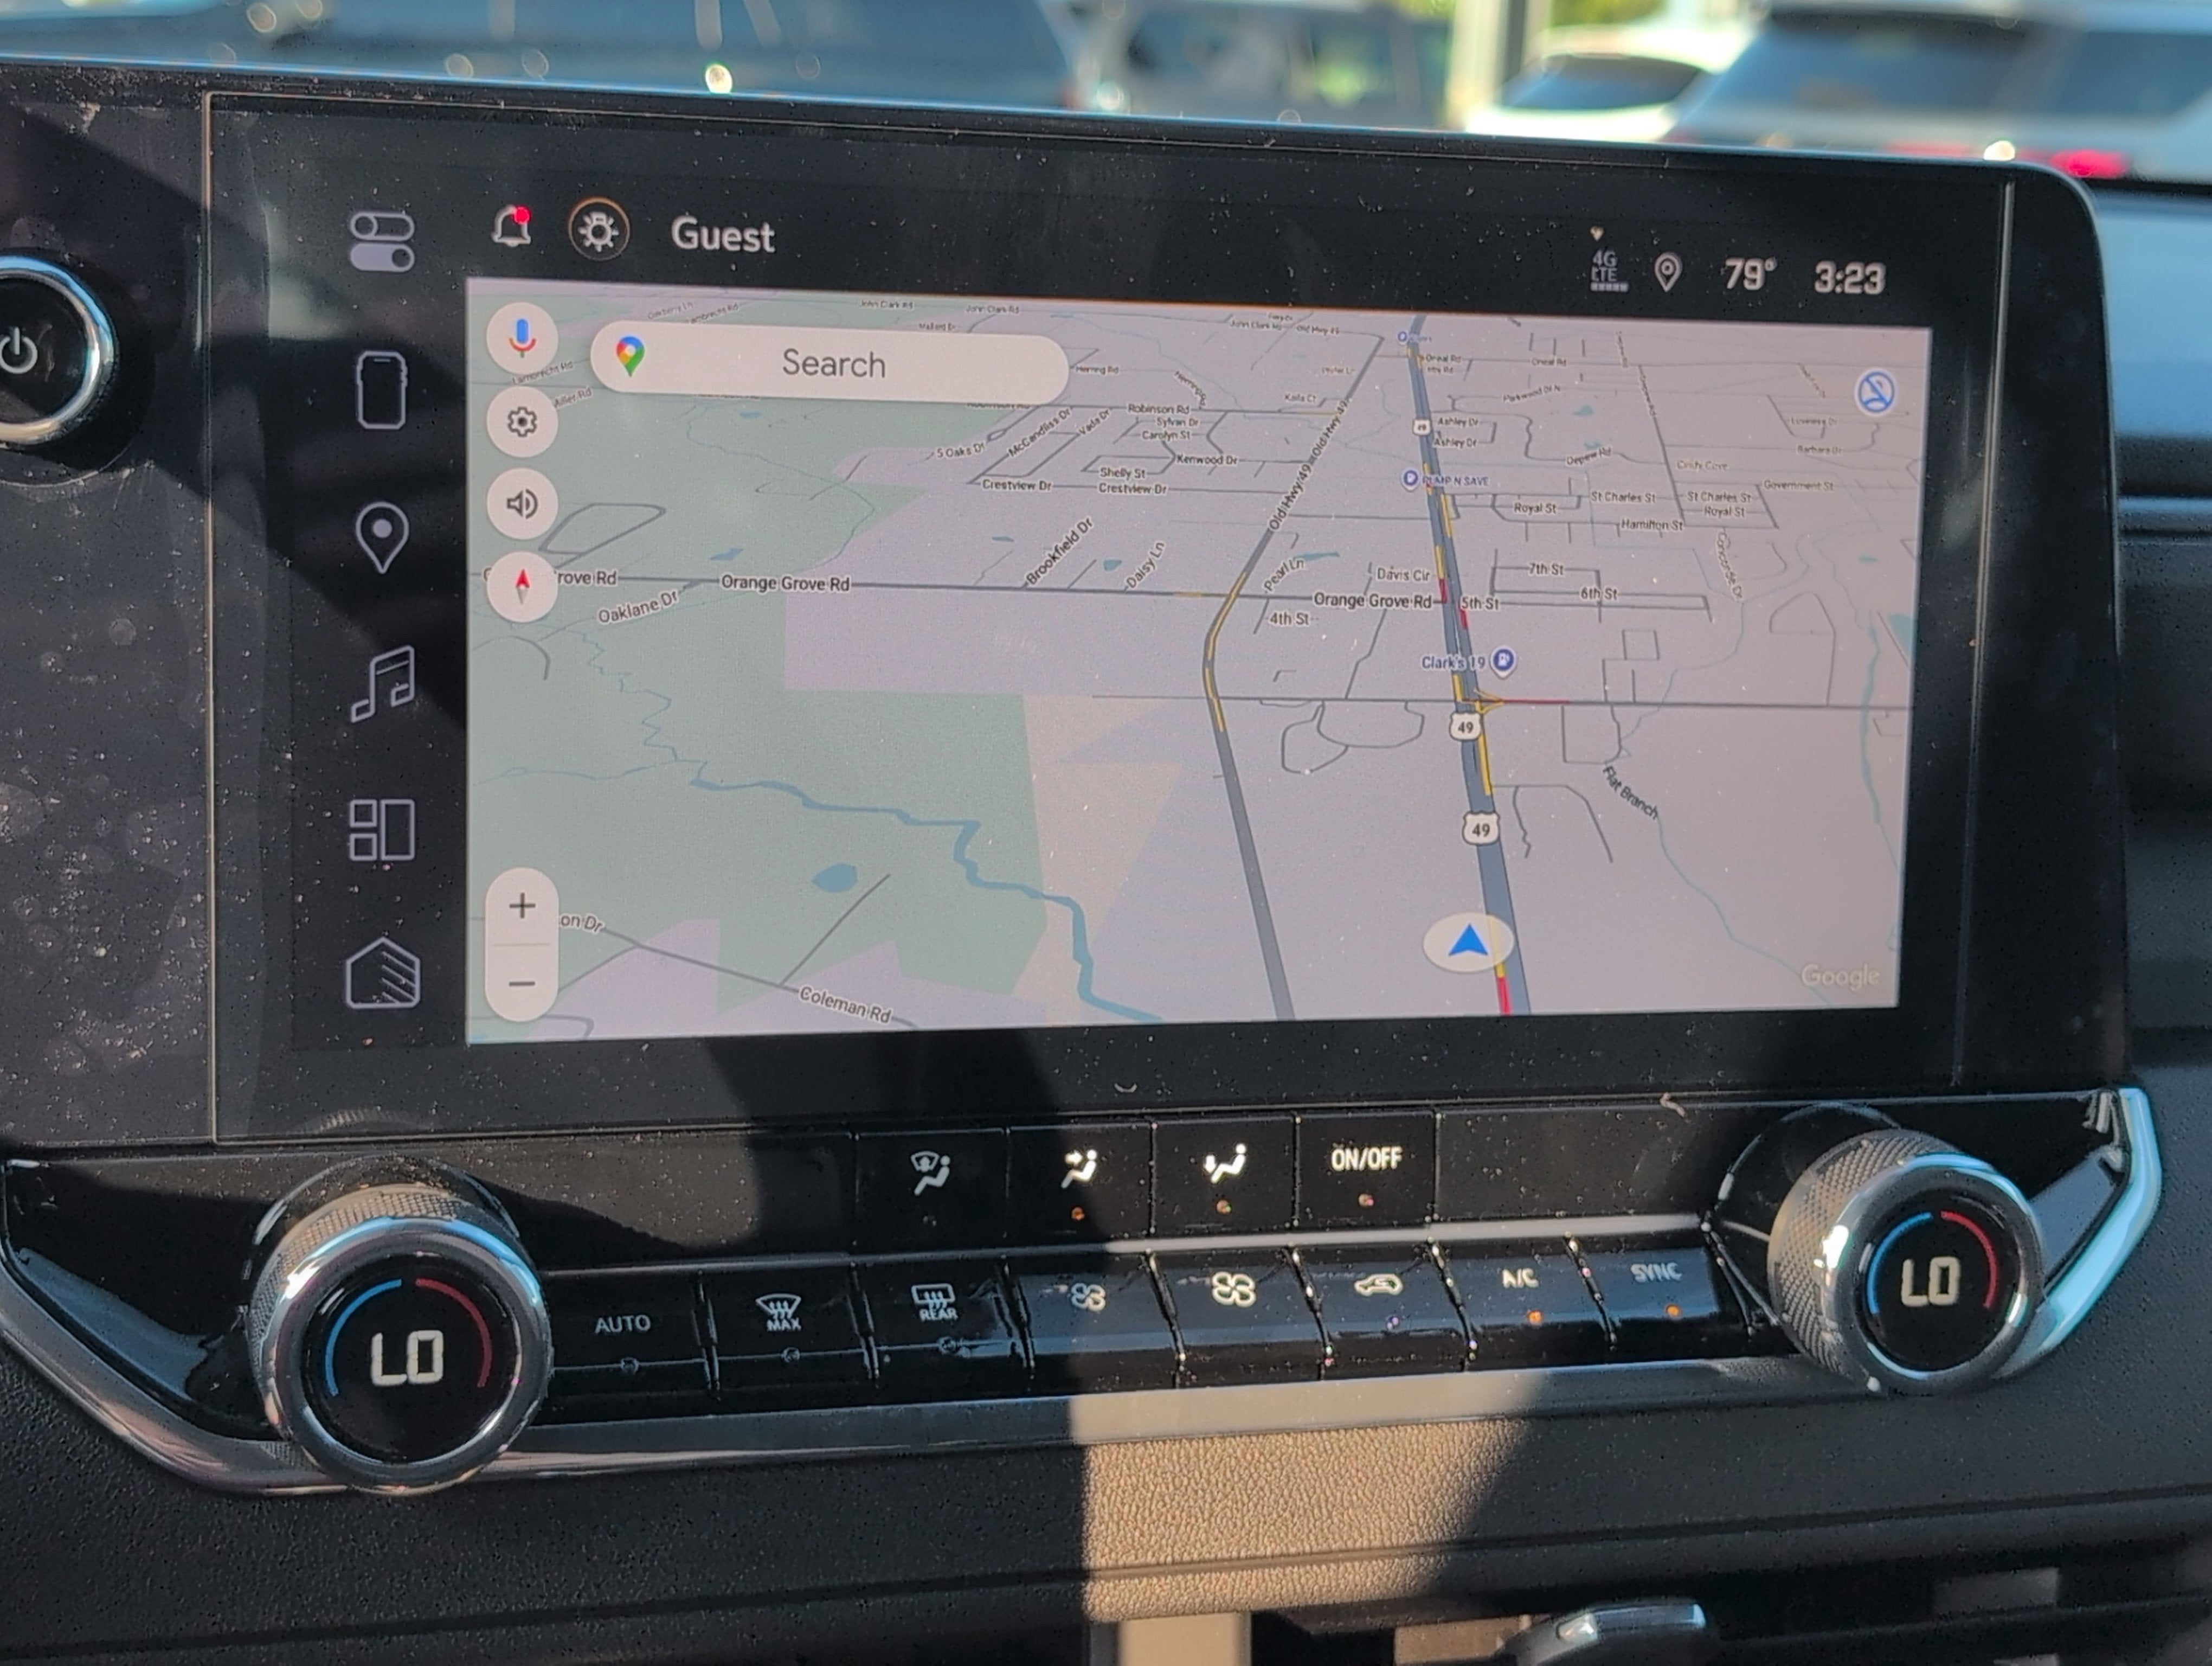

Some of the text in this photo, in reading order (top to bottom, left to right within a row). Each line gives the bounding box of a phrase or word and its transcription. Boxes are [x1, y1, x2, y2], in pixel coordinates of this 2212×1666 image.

[671, 216, 775, 253] Guest
[1593, 250, 1618, 266] 4G
[1590, 266, 1618, 282] LTE
[1724, 257, 1778, 291] 79°
[1814, 260, 1886, 296] 3:23
[782, 348, 886, 378] Search
[578, 387, 592, 399] Rd
[1058, 408, 1071, 420] Dr
[1099, 409, 1109, 420] Dr
[1128, 404, 1190, 414] Robinson Rd
[1188, 418, 1199, 427] Dr
[1179, 431, 1191, 439] St
[946, 447, 972, 458] Oaks
[973, 441, 986, 453] Dr
[1311, 437, 1327, 457] Old
[1176, 454, 1238, 465] Kenwood Dr
[1100, 467, 1146, 479] Shelly St
[982, 479, 1052, 491] Crestview Dr
[1454, 476, 1462, 485] N
[1464, 477, 1489, 486] SAVE
[1823, 482, 1834, 491] St
[1099, 484, 1167, 494] Crestview Dr
[1269, 464, 1311, 530] Old Hwy 49
[1591, 492, 1656, 503] St Charles St
[1687, 492, 1752, 503] St Charles St
[1514, 502, 1557, 514] Royal St
[1704, 506, 1745, 518] Royal St
[1622, 519, 1683, 532] Hamilton St
[1026, 517, 1095, 585] Brookfield Dr
[1126, 541, 1165, 589] Daisy Ln
[1529, 562, 1565, 576] 7th St
[554, 570, 617, 585] rove Rd
[1264, 559, 1304, 592] Pearl Ln
[1377, 566, 1431, 582] Davis Cir
[722, 574, 850, 592] Orange Grove Rd
[1314, 592, 1432, 611] Orange Grove Rd
[1580, 587, 1618, 601] 6th St
[598, 591, 677, 624] Oaklane Dr
[1461, 598, 1500, 611] 5th St
[1269, 613, 1310, 625] 4th St
[1422, 656, 1486, 669] Clark's 19
[1457, 721, 1474, 734] 49
[1602, 766, 1658, 821] Flat Branch
[1472, 823, 1491, 837] 49
[584, 915, 603, 933] Dr
[1801, 964, 1880, 991] Google
[799, 985, 892, 1024] Coleman Rd
[1331, 1145, 1403, 1172] ON/OFF
[1502, 1267, 1539, 1289] A/C
[1630, 1262, 1682, 1283] SYNC
[1900, 1256, 1960, 1307] LO
[919, 1308, 958, 1321] REAR
[595, 1314, 651, 1334] AUTO
[766, 1318, 801, 1332] MAX
[370, 1329, 445, 1387] LO
